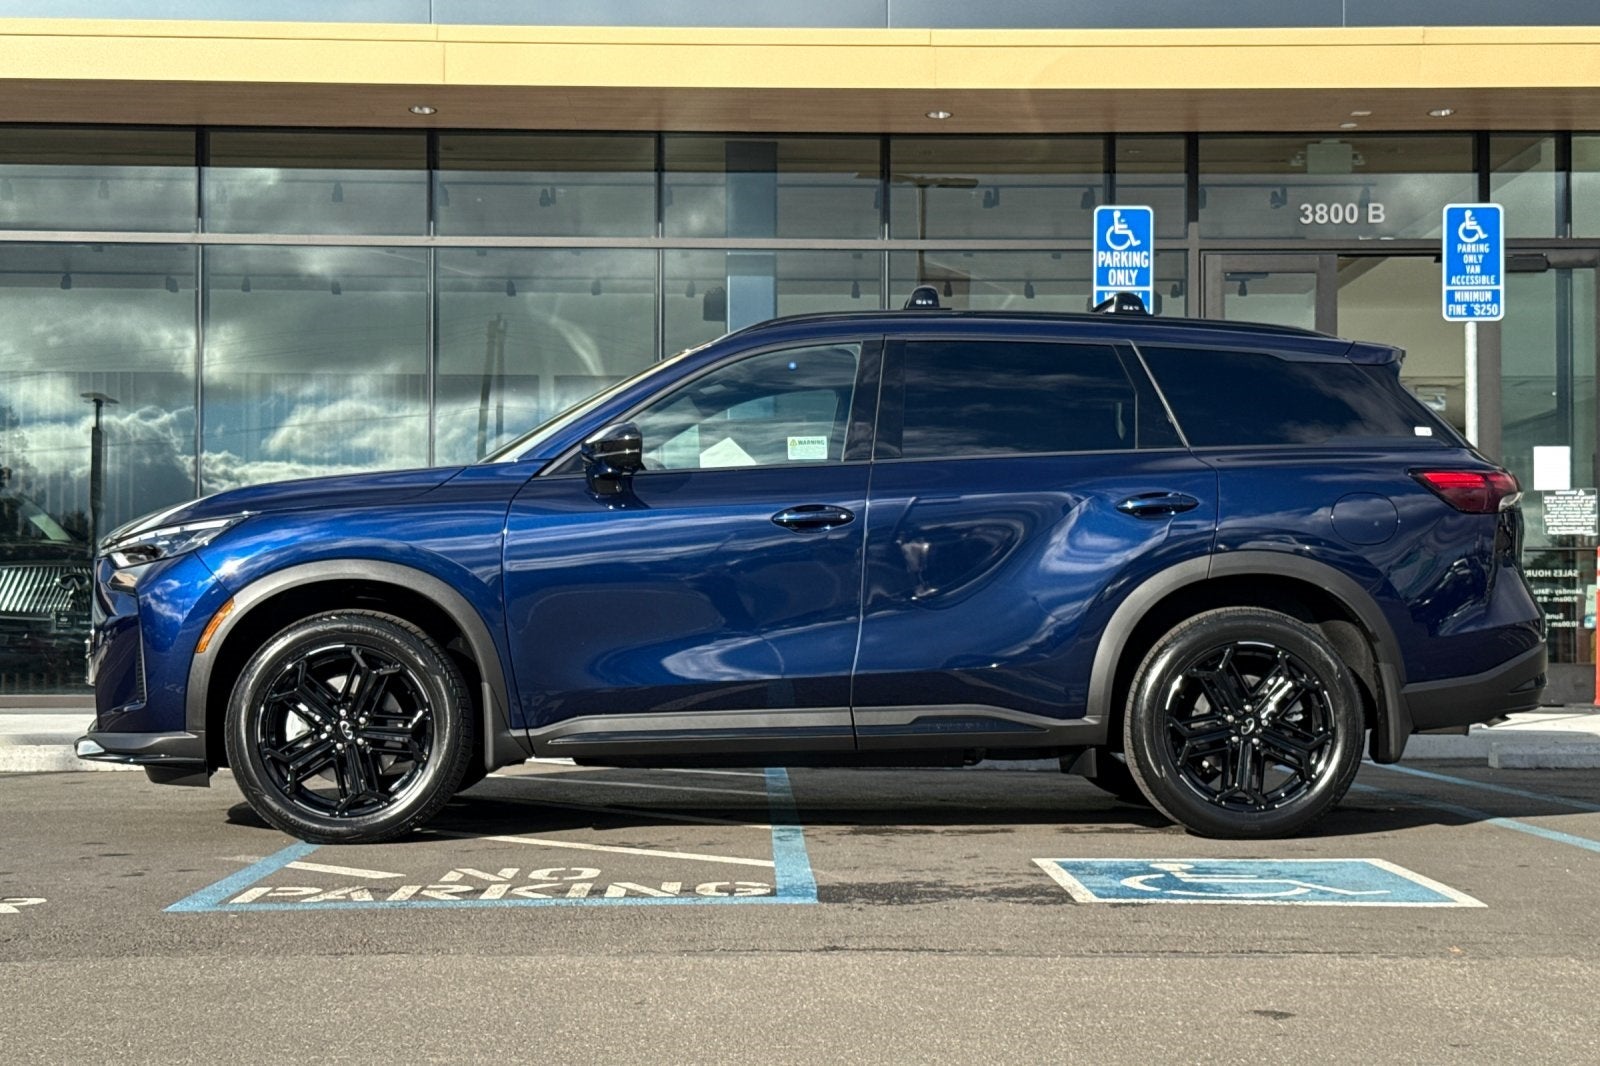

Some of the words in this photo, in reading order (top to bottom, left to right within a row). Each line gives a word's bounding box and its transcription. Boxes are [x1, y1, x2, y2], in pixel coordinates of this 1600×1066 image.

[1299, 203, 1359, 225] 3800
[1367, 203, 1385, 224] B
[1457, 243, 1490, 254] PARKING
[1098, 251, 1149, 268] PARKING
[1463, 254, 1483, 264] ONLY
[1465, 264, 1481, 274] VAN
[1108, 269, 1138, 286] ONLY
[1451, 275, 1496, 285] ACCESSIBLE
[1454, 291, 1492, 303] MINIMUM
[1448, 304, 1467, 316] FINE
[438, 867, 602, 882] NO
[228, 881, 771, 904] PARKING
